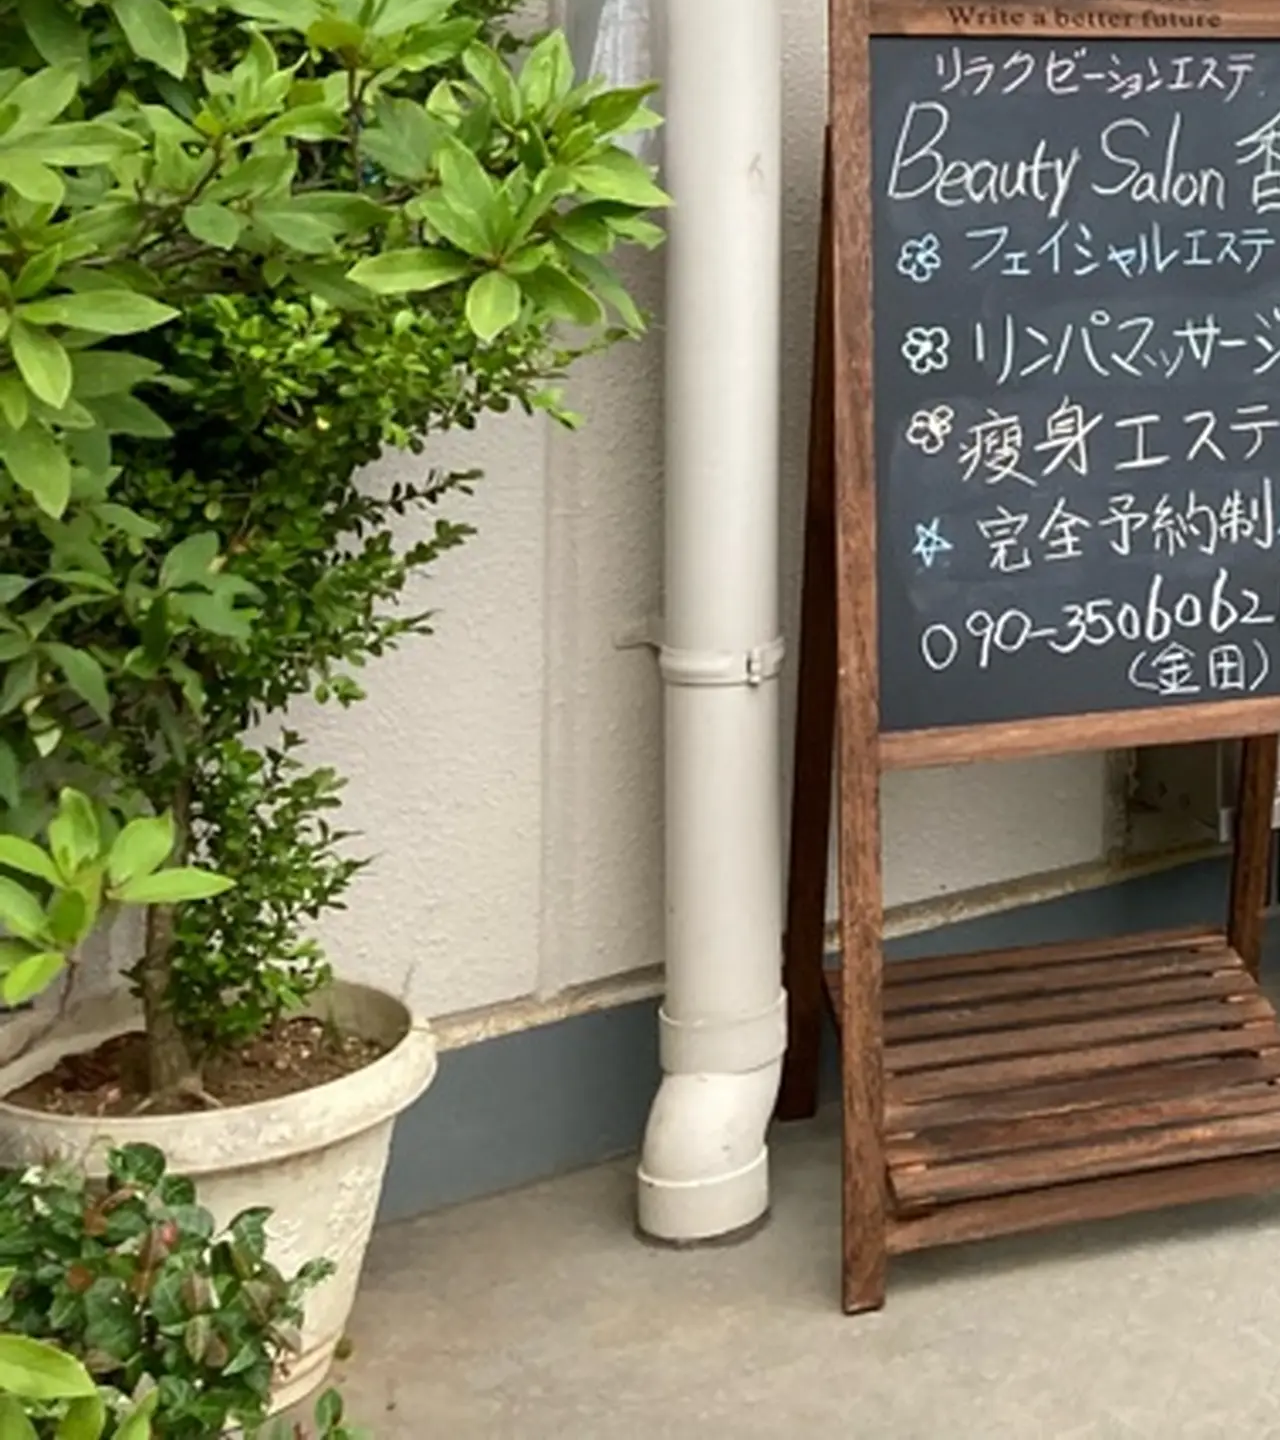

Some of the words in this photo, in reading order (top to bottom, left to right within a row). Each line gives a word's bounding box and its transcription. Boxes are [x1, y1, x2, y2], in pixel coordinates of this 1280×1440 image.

[946, 6, 1024, 27] Write
[1033, 11, 1046, 26] a
[1052, 8, 1133, 28] better
[1142, 8, 1222, 29] future
[936, 46, 1257, 103] リラクゼーションエステ
[887, 101, 1081, 219] Beauty
[1091, 111, 1226, 210] Salon
[965, 221, 1276, 278] フェイシャルエステ
[975, 477, 1274, 573] 完全予約制
[1127, 639, 1270, 696] (金田)
